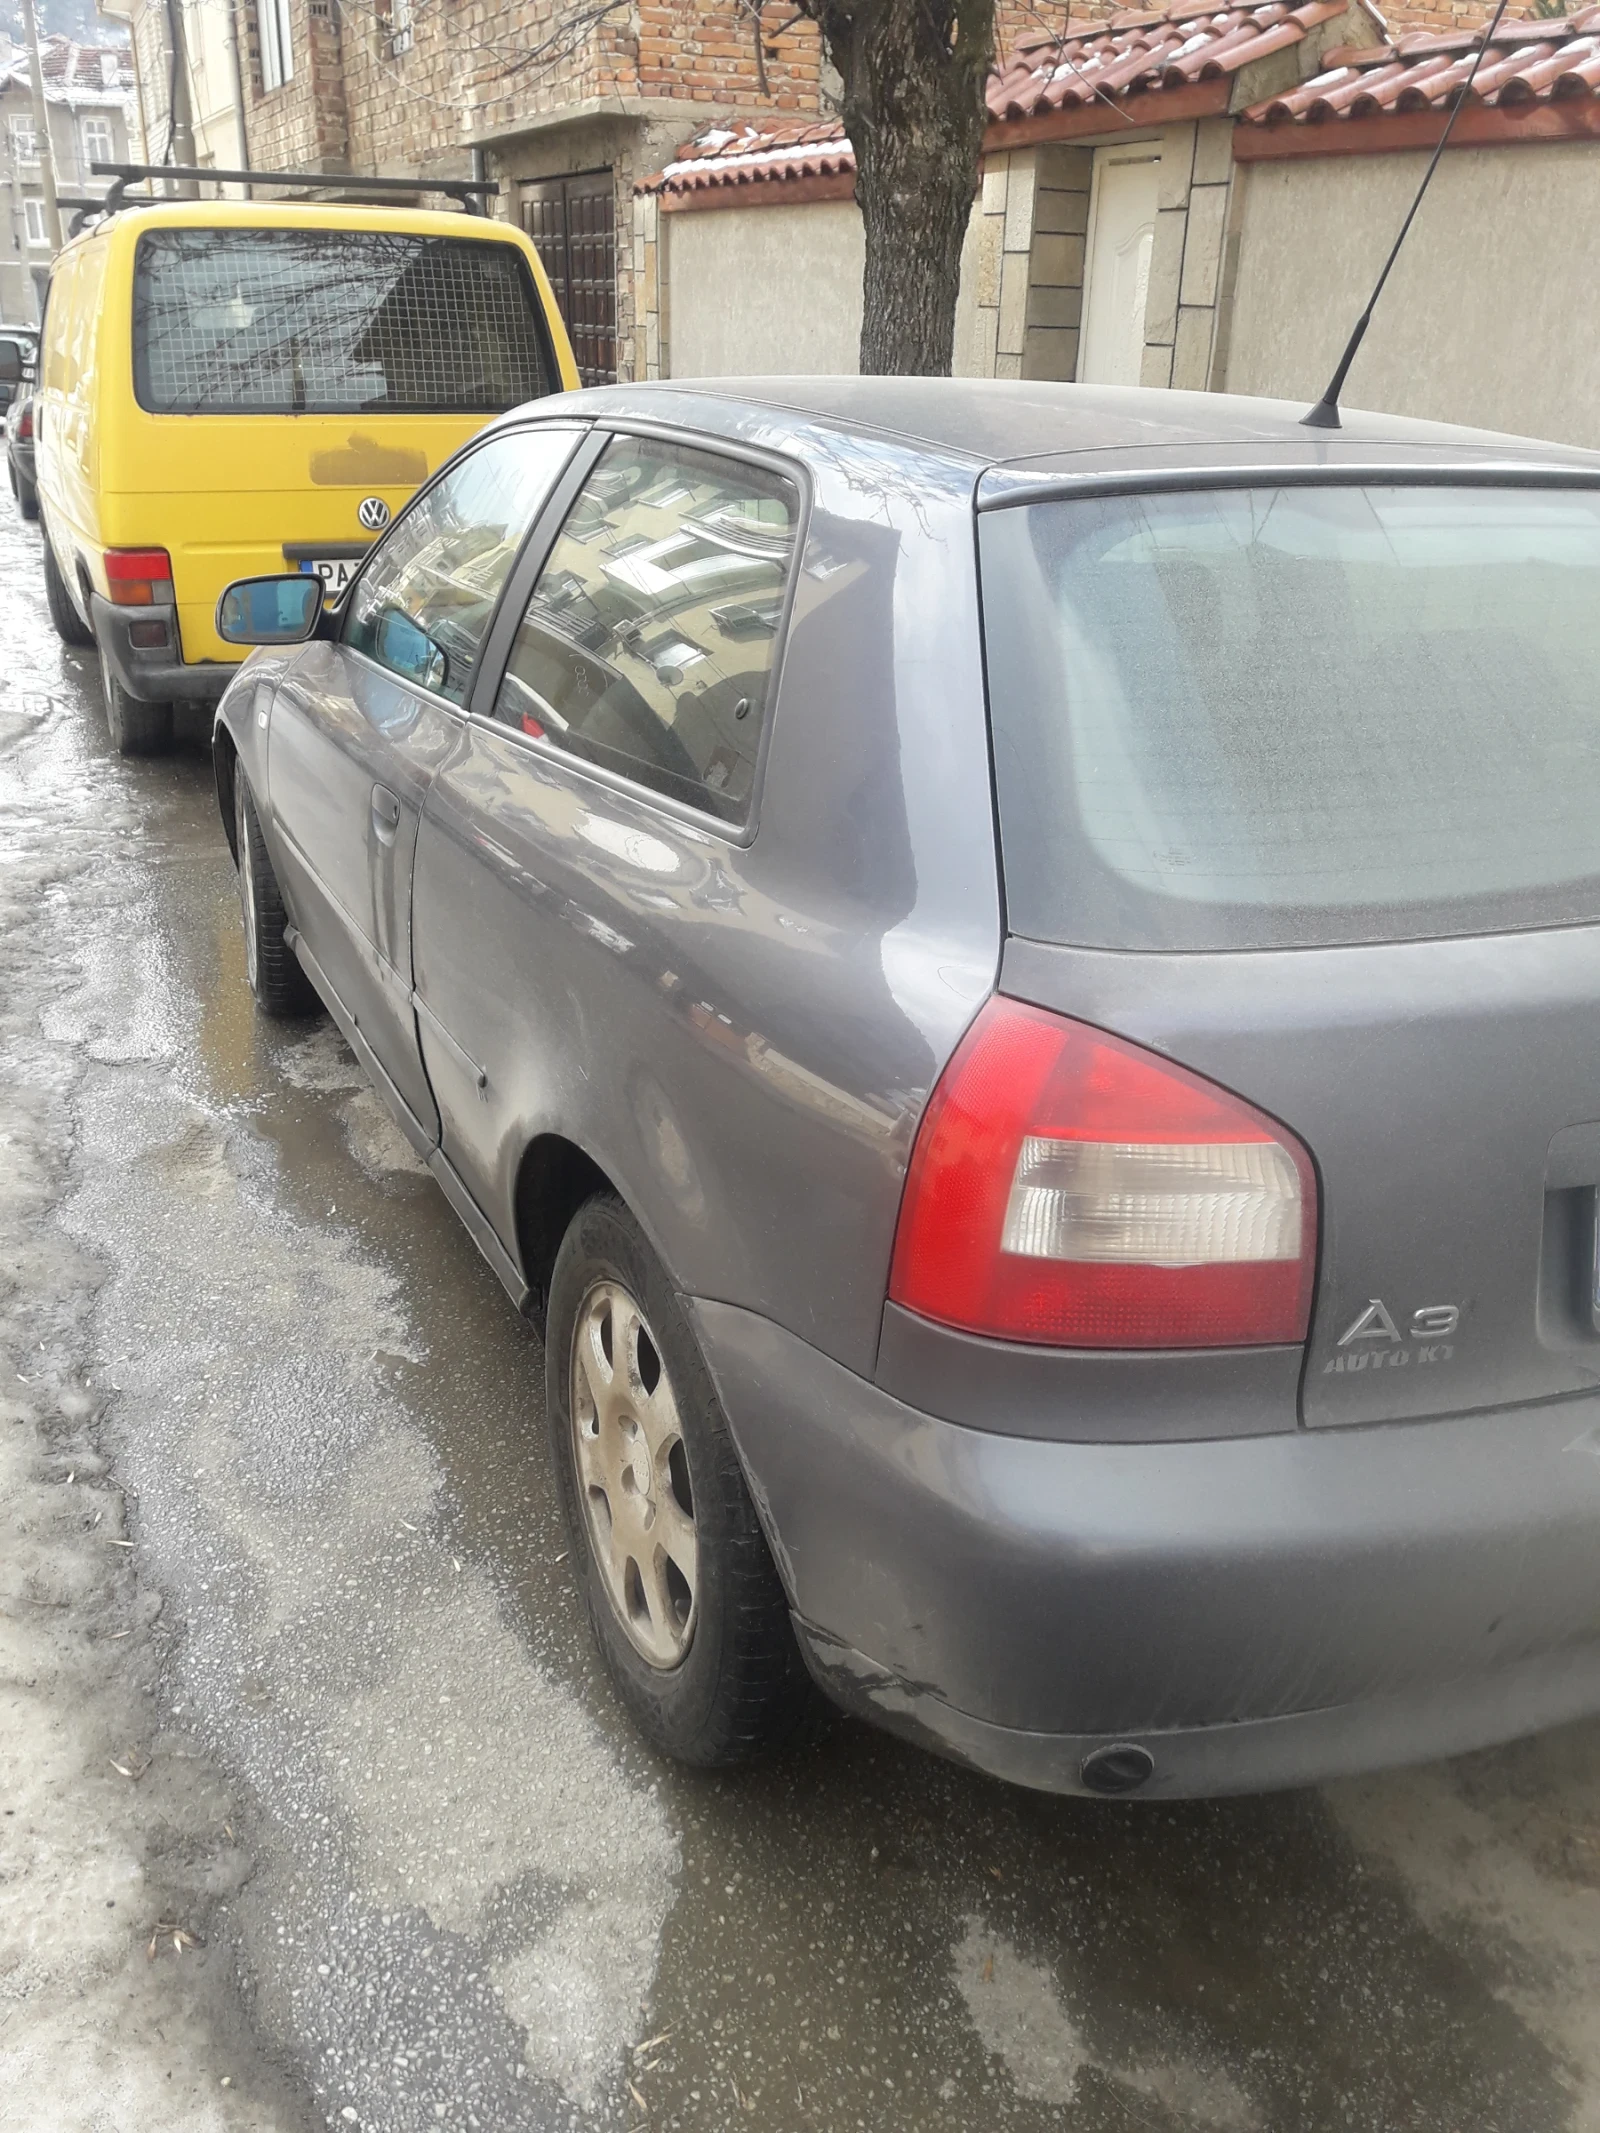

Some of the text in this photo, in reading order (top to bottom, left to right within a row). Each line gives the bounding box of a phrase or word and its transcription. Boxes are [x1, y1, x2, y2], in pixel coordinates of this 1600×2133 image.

[359, 497, 390, 529] VW
[318, 562, 359, 588] PA
[1336, 1299, 1460, 1346] A3
[1322, 1349, 1410, 1374] AUTO
